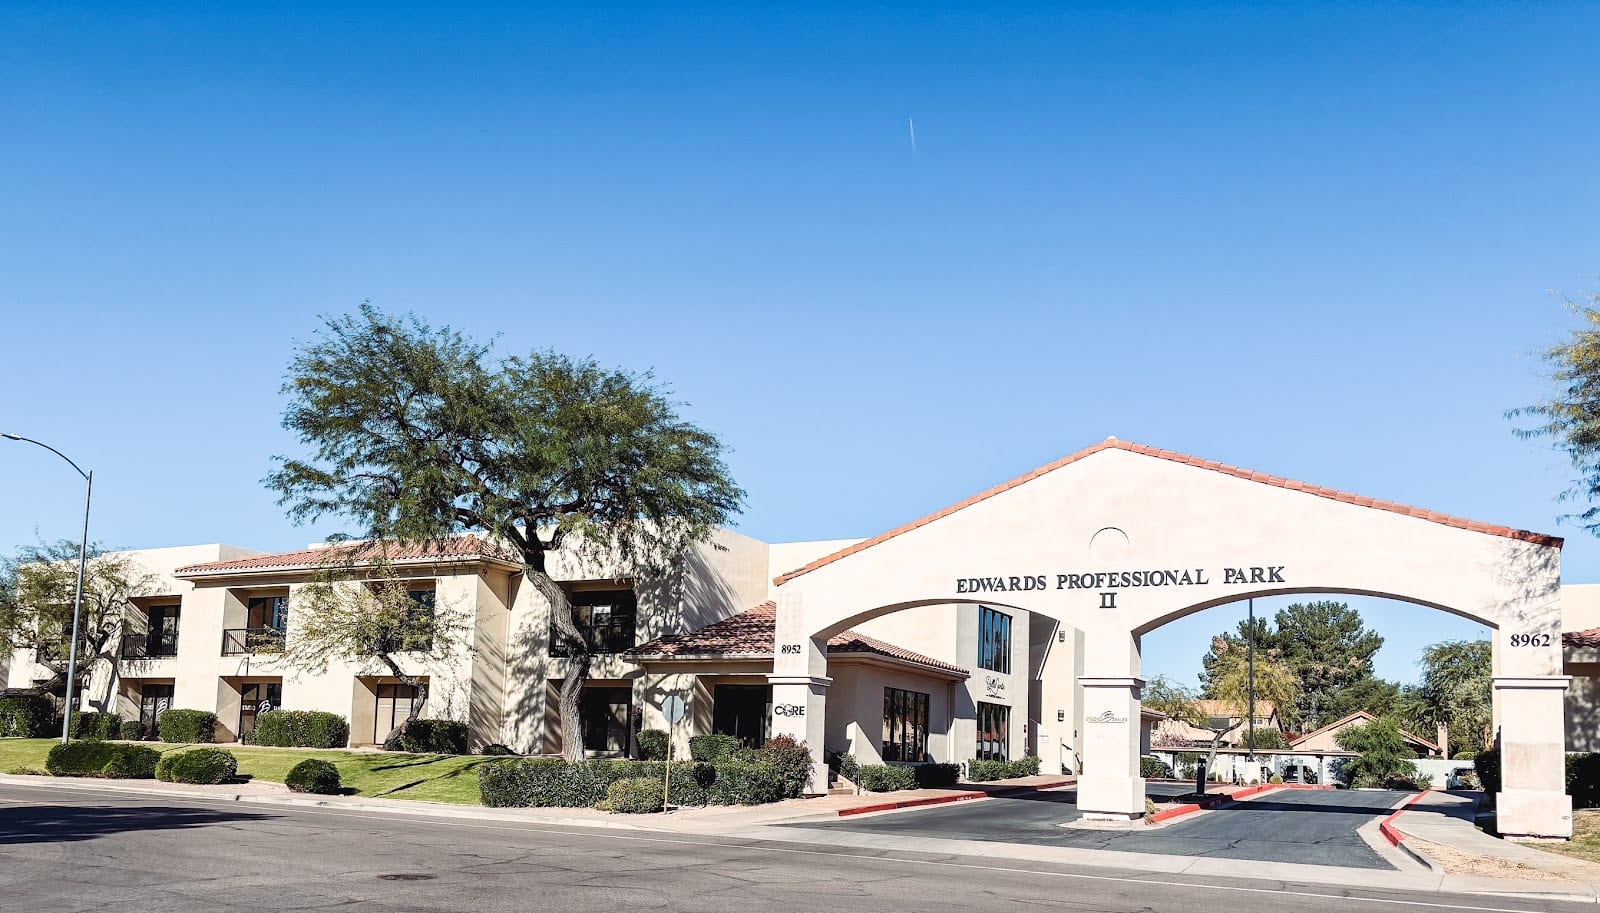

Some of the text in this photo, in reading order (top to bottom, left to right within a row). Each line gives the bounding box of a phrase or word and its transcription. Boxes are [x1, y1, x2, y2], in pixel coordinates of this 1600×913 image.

[956, 566, 1286, 594] EDWARDS PROFESSIONAL PARK
[1099, 592, 1118, 609] II
[1510, 633, 1550, 647] 8962
[781, 644, 801, 655] 8952
[774, 703, 806, 717] CORE
